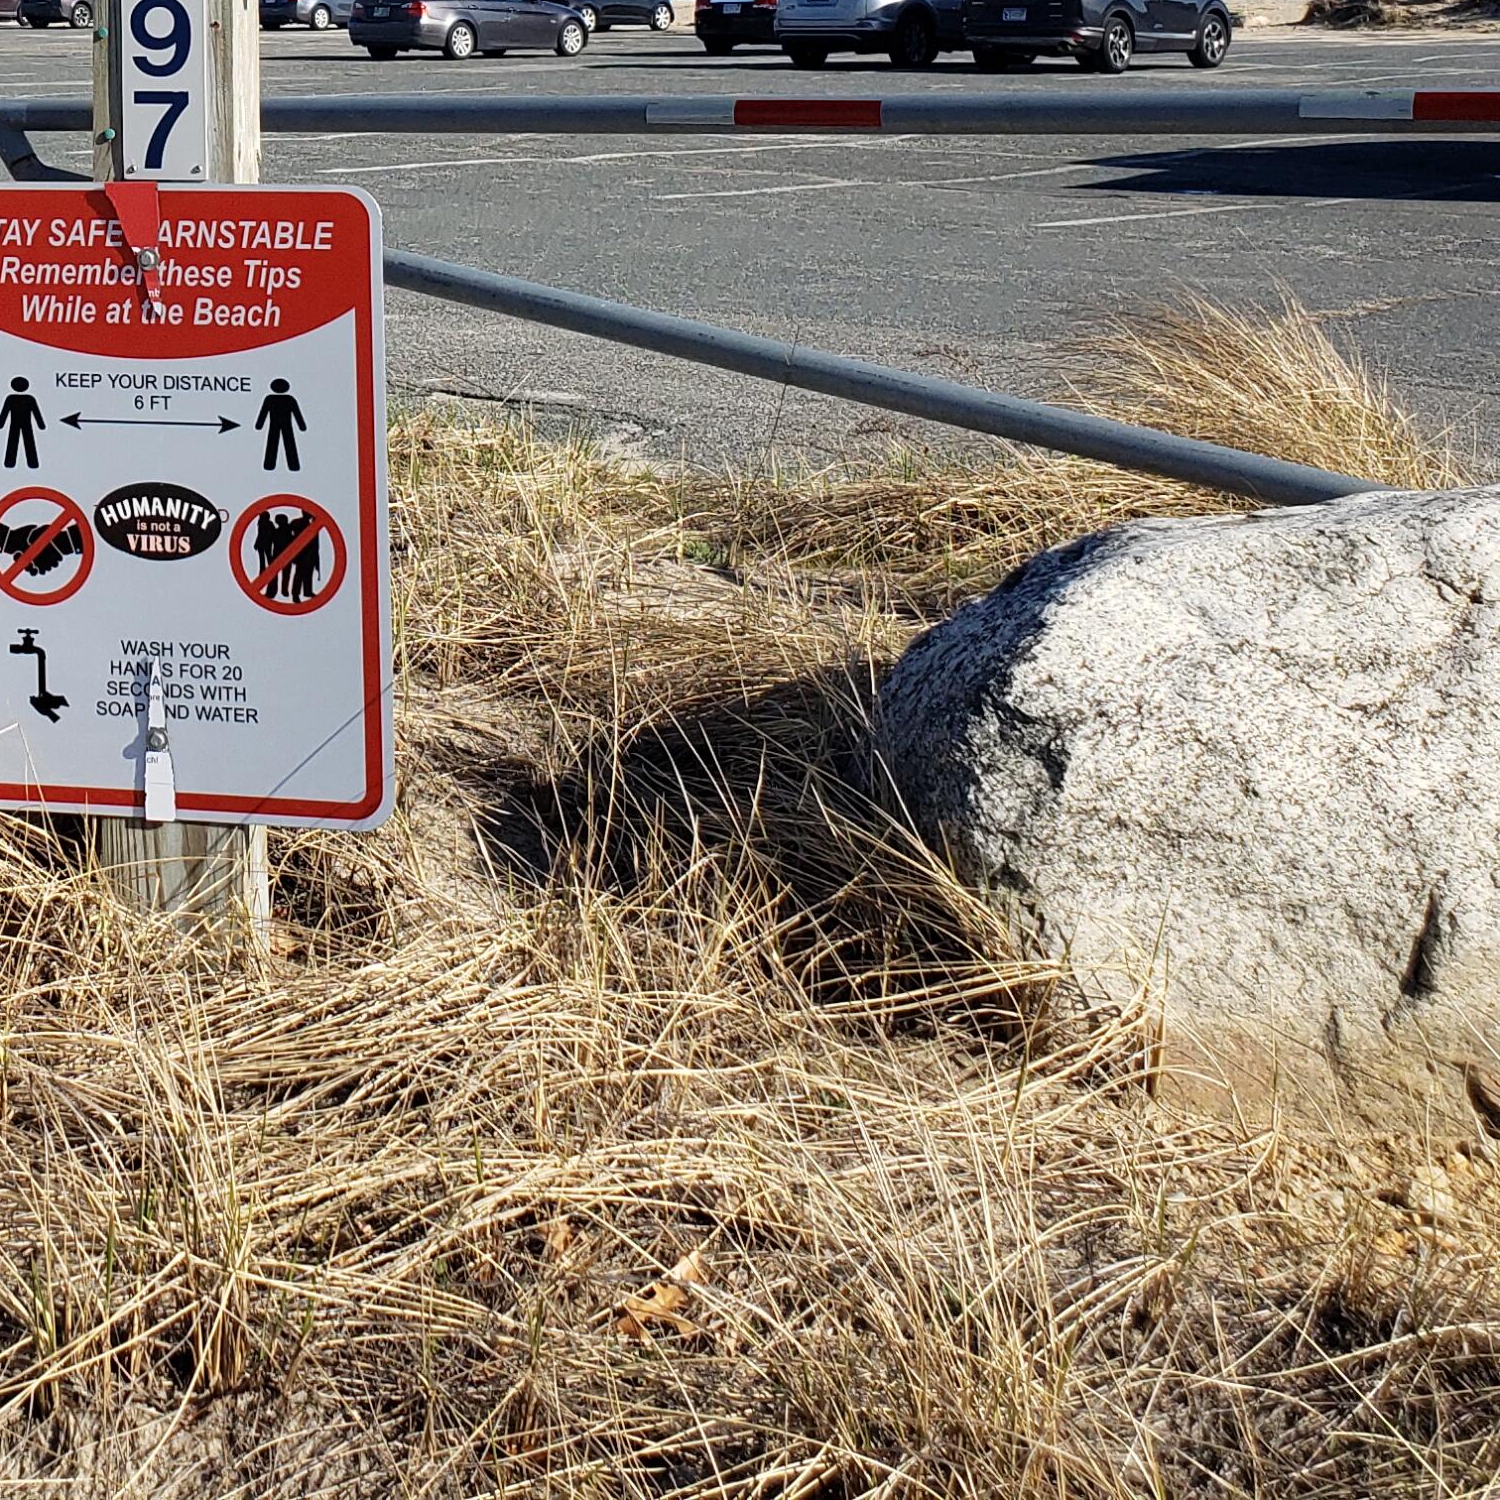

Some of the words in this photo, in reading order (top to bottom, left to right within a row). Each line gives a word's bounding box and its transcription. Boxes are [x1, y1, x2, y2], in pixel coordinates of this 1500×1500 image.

[47, 218, 123, 247] SAFE
[158, 219, 333, 250] ARNSTABLE
[156, 259, 232, 287] these
[244, 260, 301, 295] Tips
[23, 295, 95, 323] While
[106, 299, 132, 324] at
[194, 298, 280, 326] Beach
[56, 373, 102, 388] KEEP
[108, 374, 157, 389] YOUR
[164, 376, 251, 391] DISTANCE
[135, 395, 144, 410] 6
[151, 396, 172, 410] FT
[100, 496, 217, 531] HUMANITY
[136, 520, 147, 531] is
[150, 521, 171, 532] not
[173, 522, 181, 533] a
[126, 533, 191, 553] VIRUS
[121, 640, 173, 657] WASH
[179, 643, 230, 660] YOUR
[180, 664, 216, 680] FOR
[223, 666, 242, 681] 20
[200, 685, 246, 702] WITH
[96, 701, 146, 718] SOAP
[164, 704, 190, 720] ND
[195, 706, 258, 723] WATER
